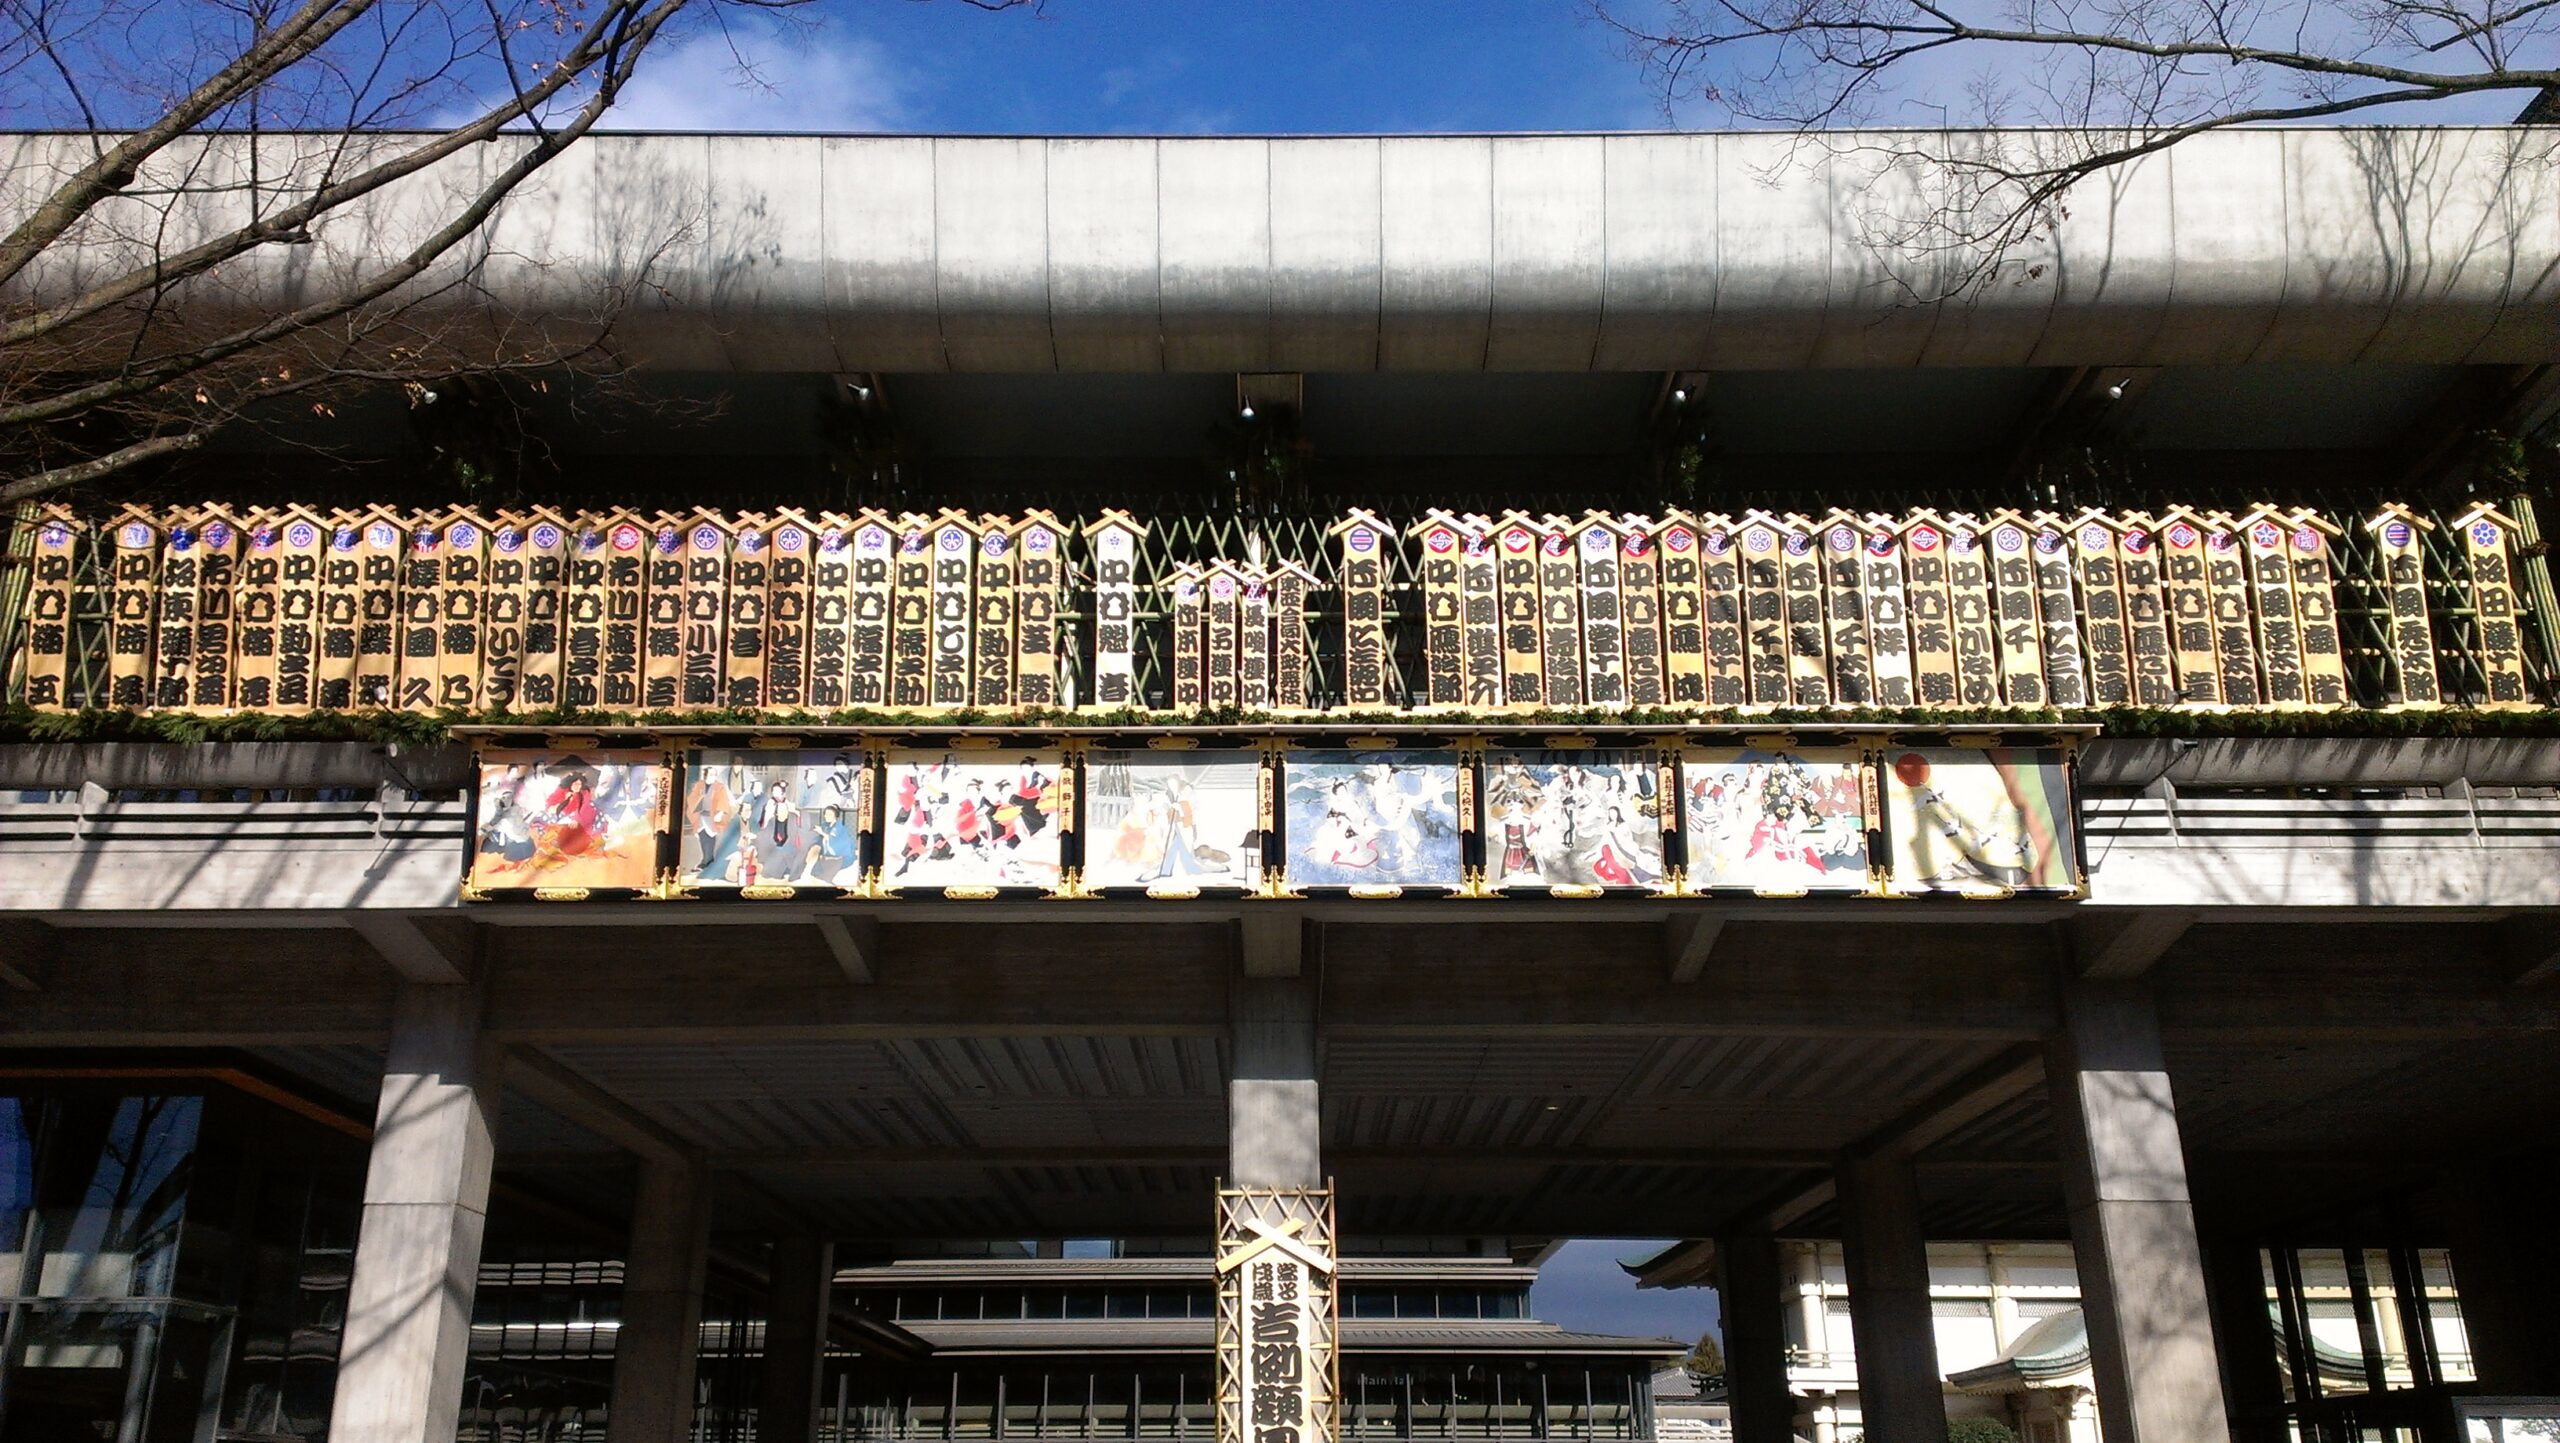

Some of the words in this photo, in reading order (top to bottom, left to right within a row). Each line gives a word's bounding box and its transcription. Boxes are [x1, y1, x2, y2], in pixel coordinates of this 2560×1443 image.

[683, 557, 721, 705] 中村小三郎
[811, 561, 848, 706] 中村歌之助
[933, 558, 967, 703] 中村七之助
[977, 562, 1011, 706] 中村勘九郎
[1020, 558, 1053, 703] 中村芝翫
[1280, 576, 1302, 705] 東西合同大歌舞伎
[1347, 558, 1381, 703] 片岡仁左衛門
[1951, 561, 1995, 704] 中村かなめ
[2473, 553, 2523, 701] 坂田藤十郎
